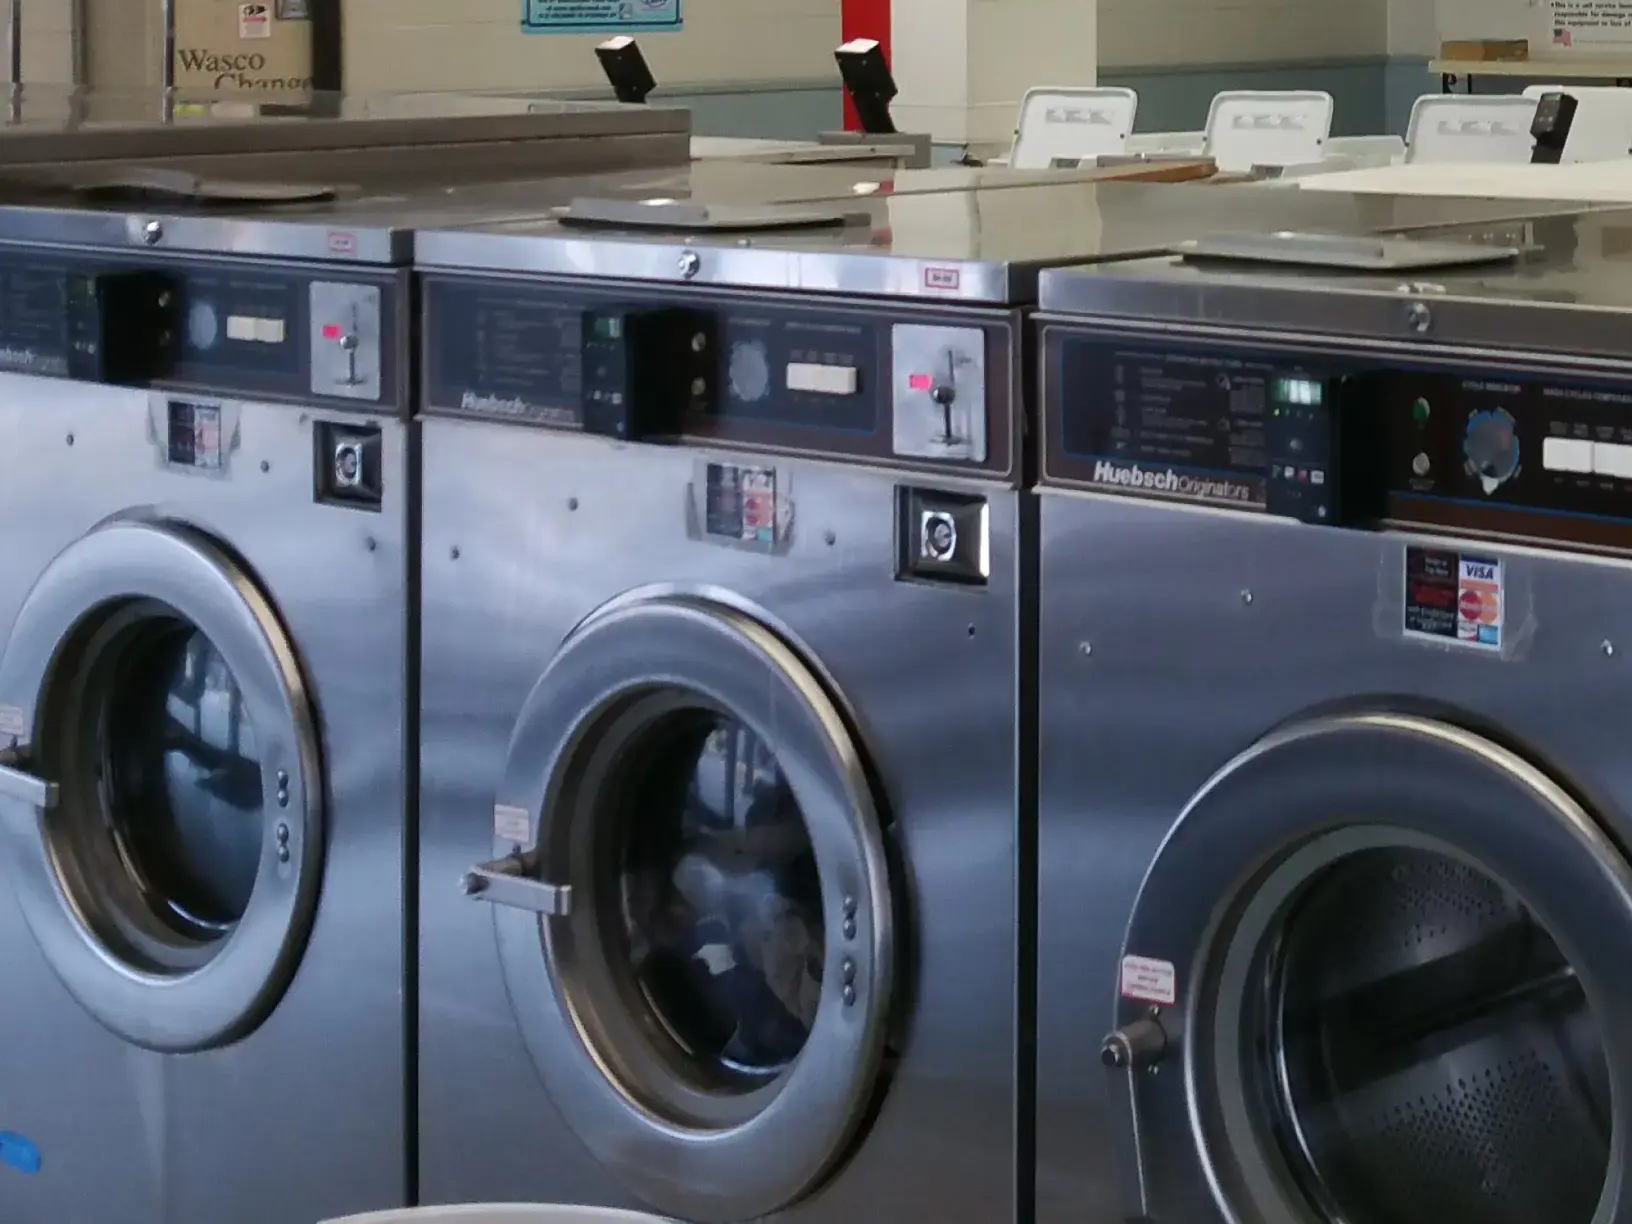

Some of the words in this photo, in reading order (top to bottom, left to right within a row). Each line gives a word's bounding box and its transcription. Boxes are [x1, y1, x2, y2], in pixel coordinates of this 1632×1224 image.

[177, 48, 266, 72] Wasco
[1093, 460, 1179, 492] Huebsch
[1178, 477, 1251, 502] Originators
[1466, 563, 1494, 580] VISA
